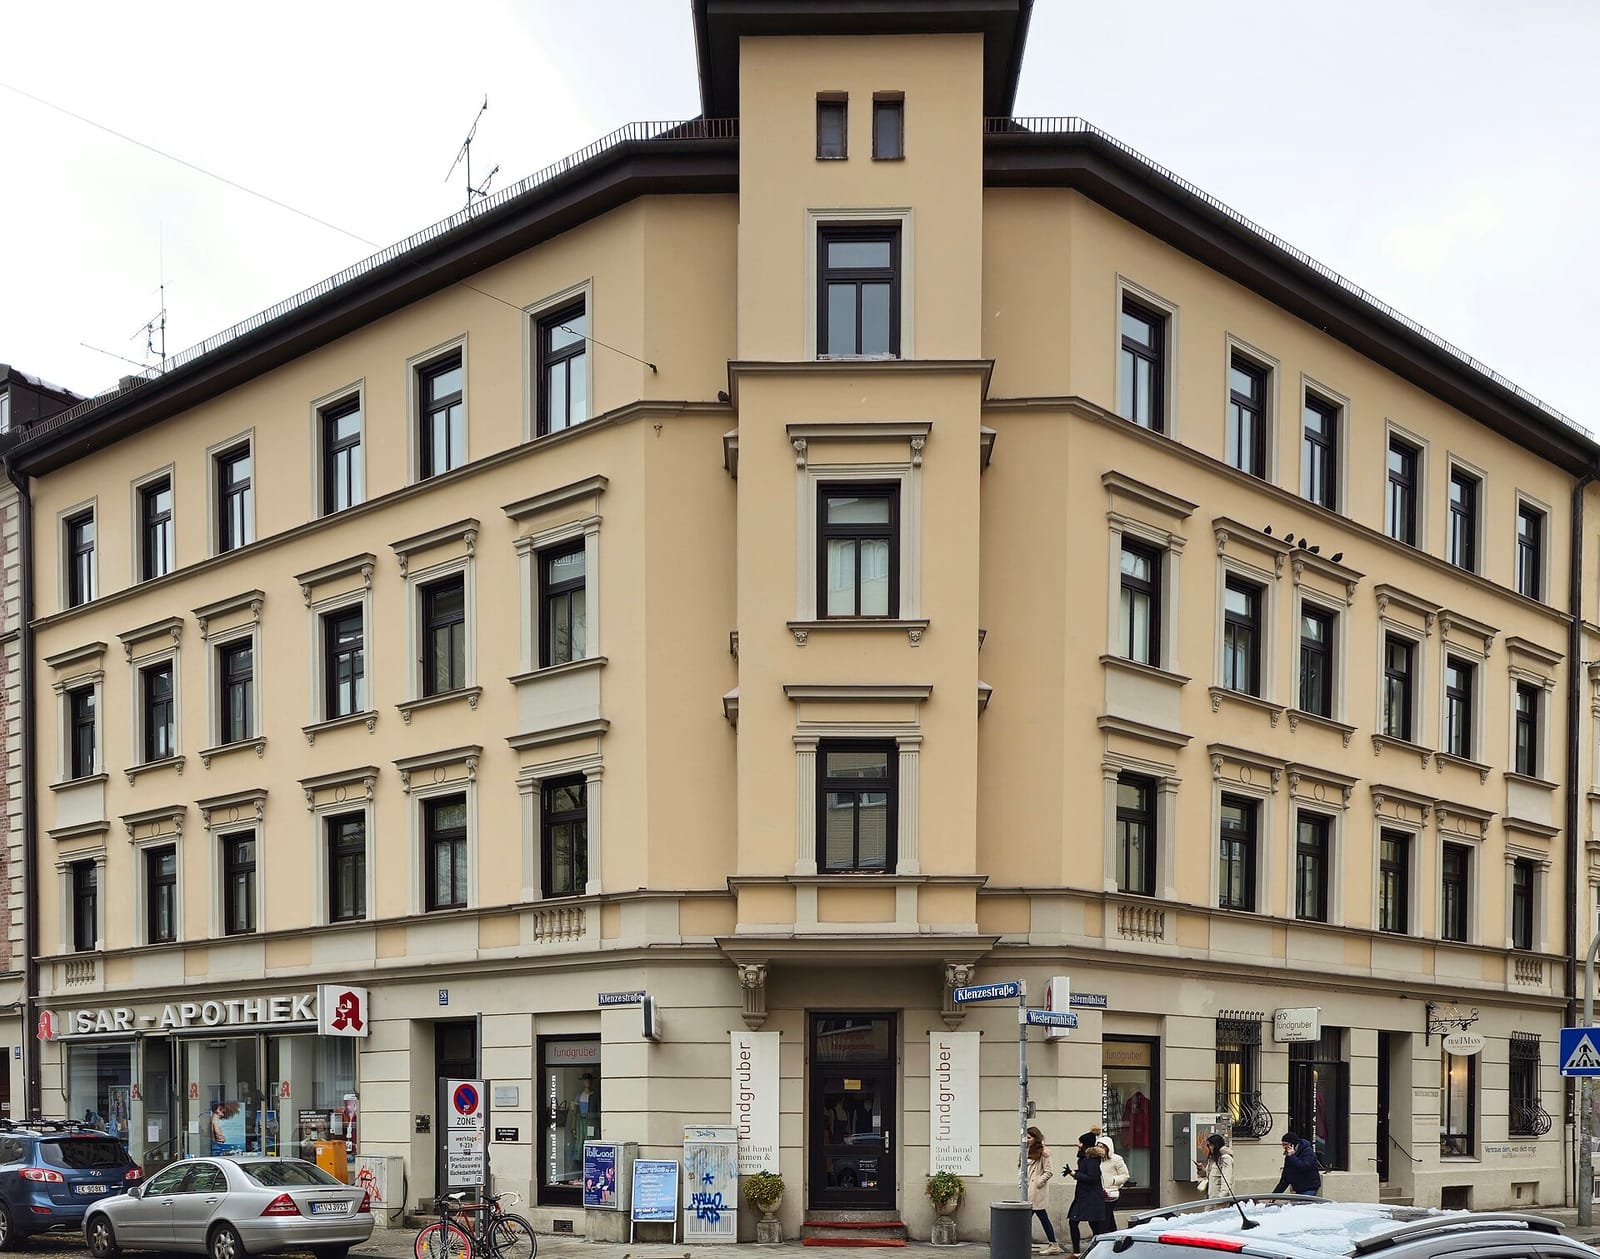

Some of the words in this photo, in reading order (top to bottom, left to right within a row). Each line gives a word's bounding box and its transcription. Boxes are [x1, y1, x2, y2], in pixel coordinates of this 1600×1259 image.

[958, 985, 1014, 1001] Klenzestraße
[1069, 994, 1106, 1005] estermühlstr.
[68, 1007, 135, 1033] ISAR
[160, 994, 318, 1028] APOTHEK
[1030, 1012, 1076, 1026] Westermühlstr.
[553, 1046, 597, 1059] fundgruber
[736, 1042, 755, 1140] fundgruber
[936, 1042, 955, 1141] fundgruber
[456, 1117, 476, 1126] ZONE
[953, 1145, 973, 1154] hand
[692, 1192, 722, 1208] HALLO
